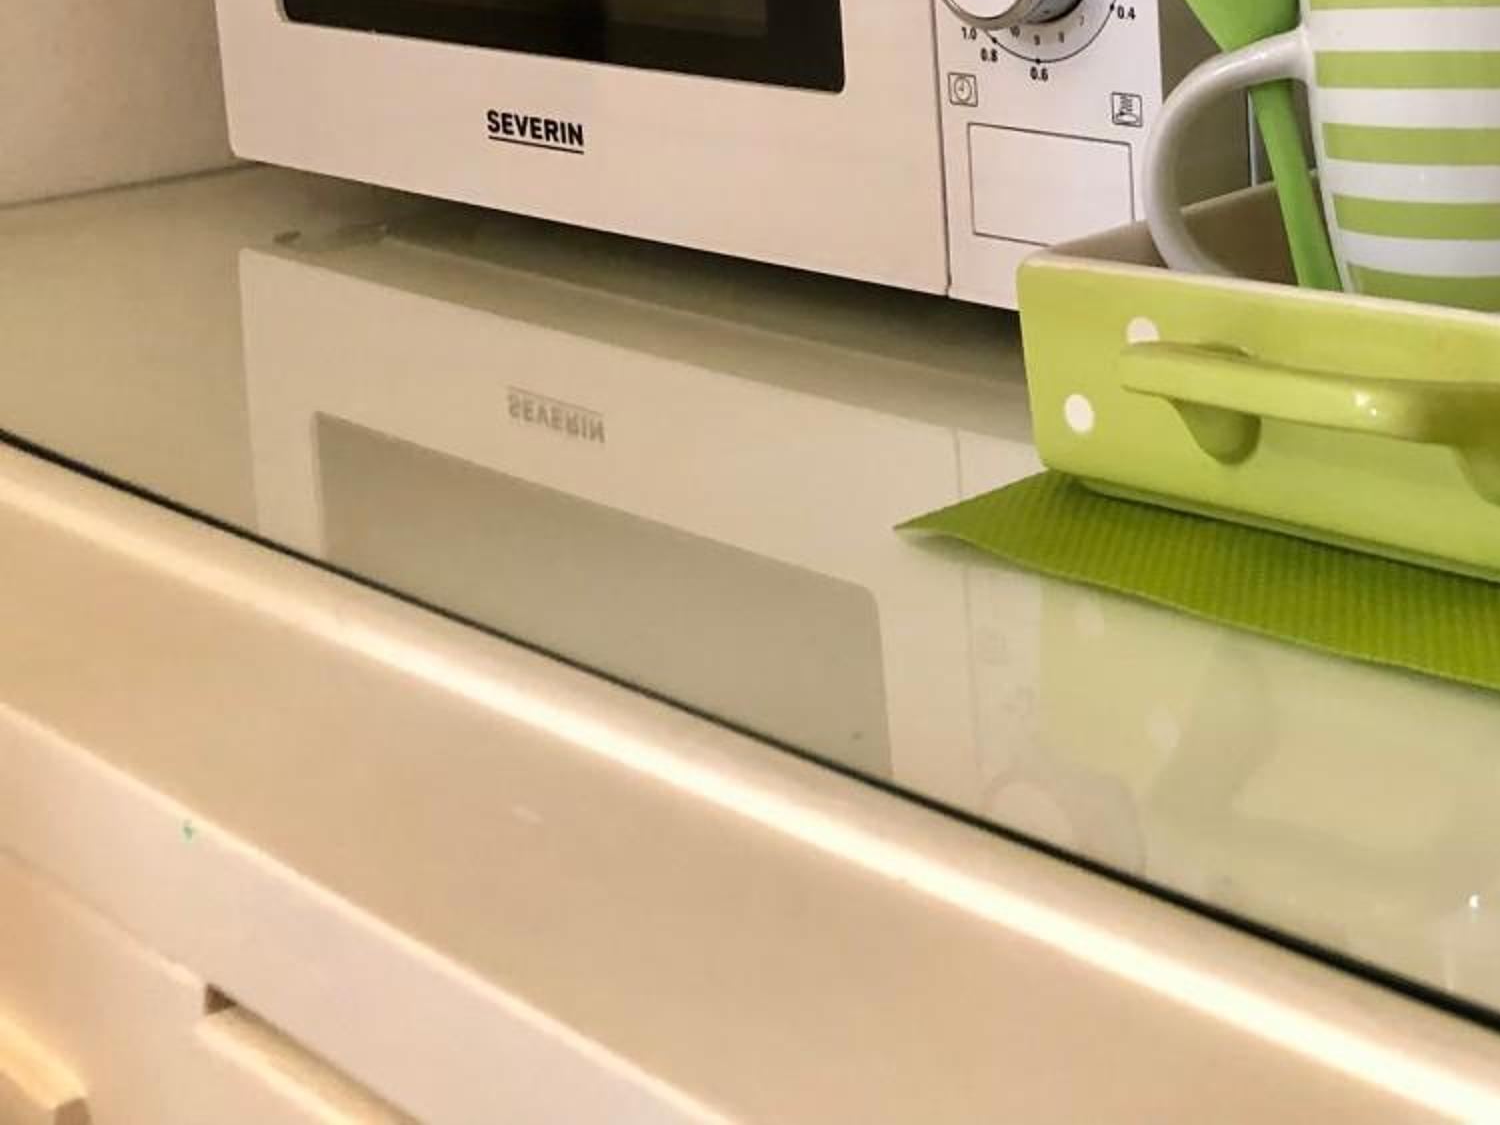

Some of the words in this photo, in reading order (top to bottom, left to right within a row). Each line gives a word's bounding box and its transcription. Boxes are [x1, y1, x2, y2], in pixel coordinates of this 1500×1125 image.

[1117, 6, 1137, 20] 0.4
[961, 26, 977, 41] 1.0
[980, 47, 998, 63] 0.8
[1030, 66, 1049, 82] 0.6
[486, 109, 584, 147] SEVERIN
